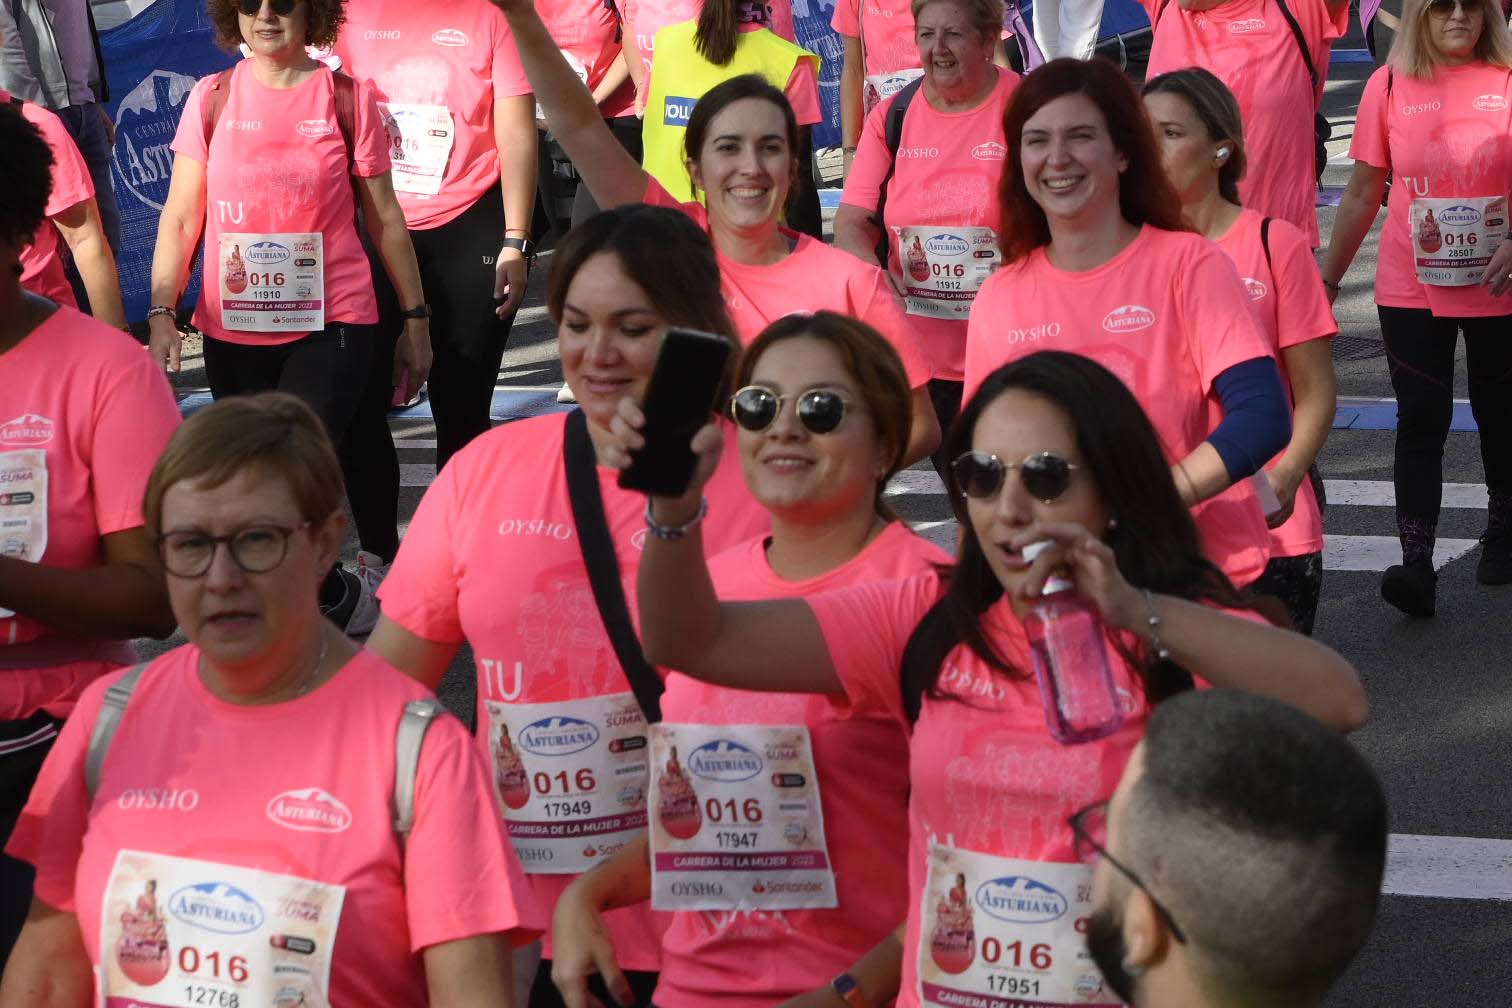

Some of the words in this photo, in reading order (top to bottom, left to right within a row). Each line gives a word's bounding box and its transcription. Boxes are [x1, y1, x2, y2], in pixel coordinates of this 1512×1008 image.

[1402, 101, 1441, 116] OYSHO
[896, 148, 939, 159] OYSHO
[1402, 176, 1429, 197] TU
[217, 200, 244, 225] TU
[928, 241, 967, 252] ASTURIANA
[1444, 232, 1478, 246] 016
[247, 248, 288, 260] ASTURIANA
[1448, 249, 1474, 257] 28507
[932, 263, 965, 278] 016
[250, 272, 286, 287] 016
[935, 280, 962, 290] 11912
[253, 290, 282, 300] 11910
[229, 315, 257, 324] OYSHO
[281, 315, 317, 325] Santander
[1106, 314, 1151, 330] ASTURIANA
[498, 518, 573, 542] OYSHO
[481, 658, 523, 701] TU
[605, 713, 642, 729] SUMA
[522, 728, 593, 749] ASTURIANA
[695, 755, 758, 773] ASTURIANA
[533, 767, 596, 795] 016
[118, 789, 199, 811] OYSHO
[274, 799, 345, 827] ASTURIANA
[543, 801, 592, 818] 17949
[705, 797, 763, 823] 016
[507, 824, 548, 836] CARRERA
[551, 823, 564, 834] DE
[566, 821, 581, 833] LA
[583, 818, 620, 833] MUJER
[716, 832, 758, 848] 17947
[673, 856, 720, 867] CARRERA
[722, 857, 734, 866] DE
[737, 857, 750, 867] LA
[752, 856, 787, 866] MUJER
[671, 881, 724, 897] OYSHO
[767, 880, 823, 893] Santander
[982, 889, 1061, 916] ASTURIANA
[178, 896, 256, 927] ASTURIANA
[980, 936, 1053, 970] 016
[178, 946, 249, 983] 016
[986, 974, 1041, 996] 17951
